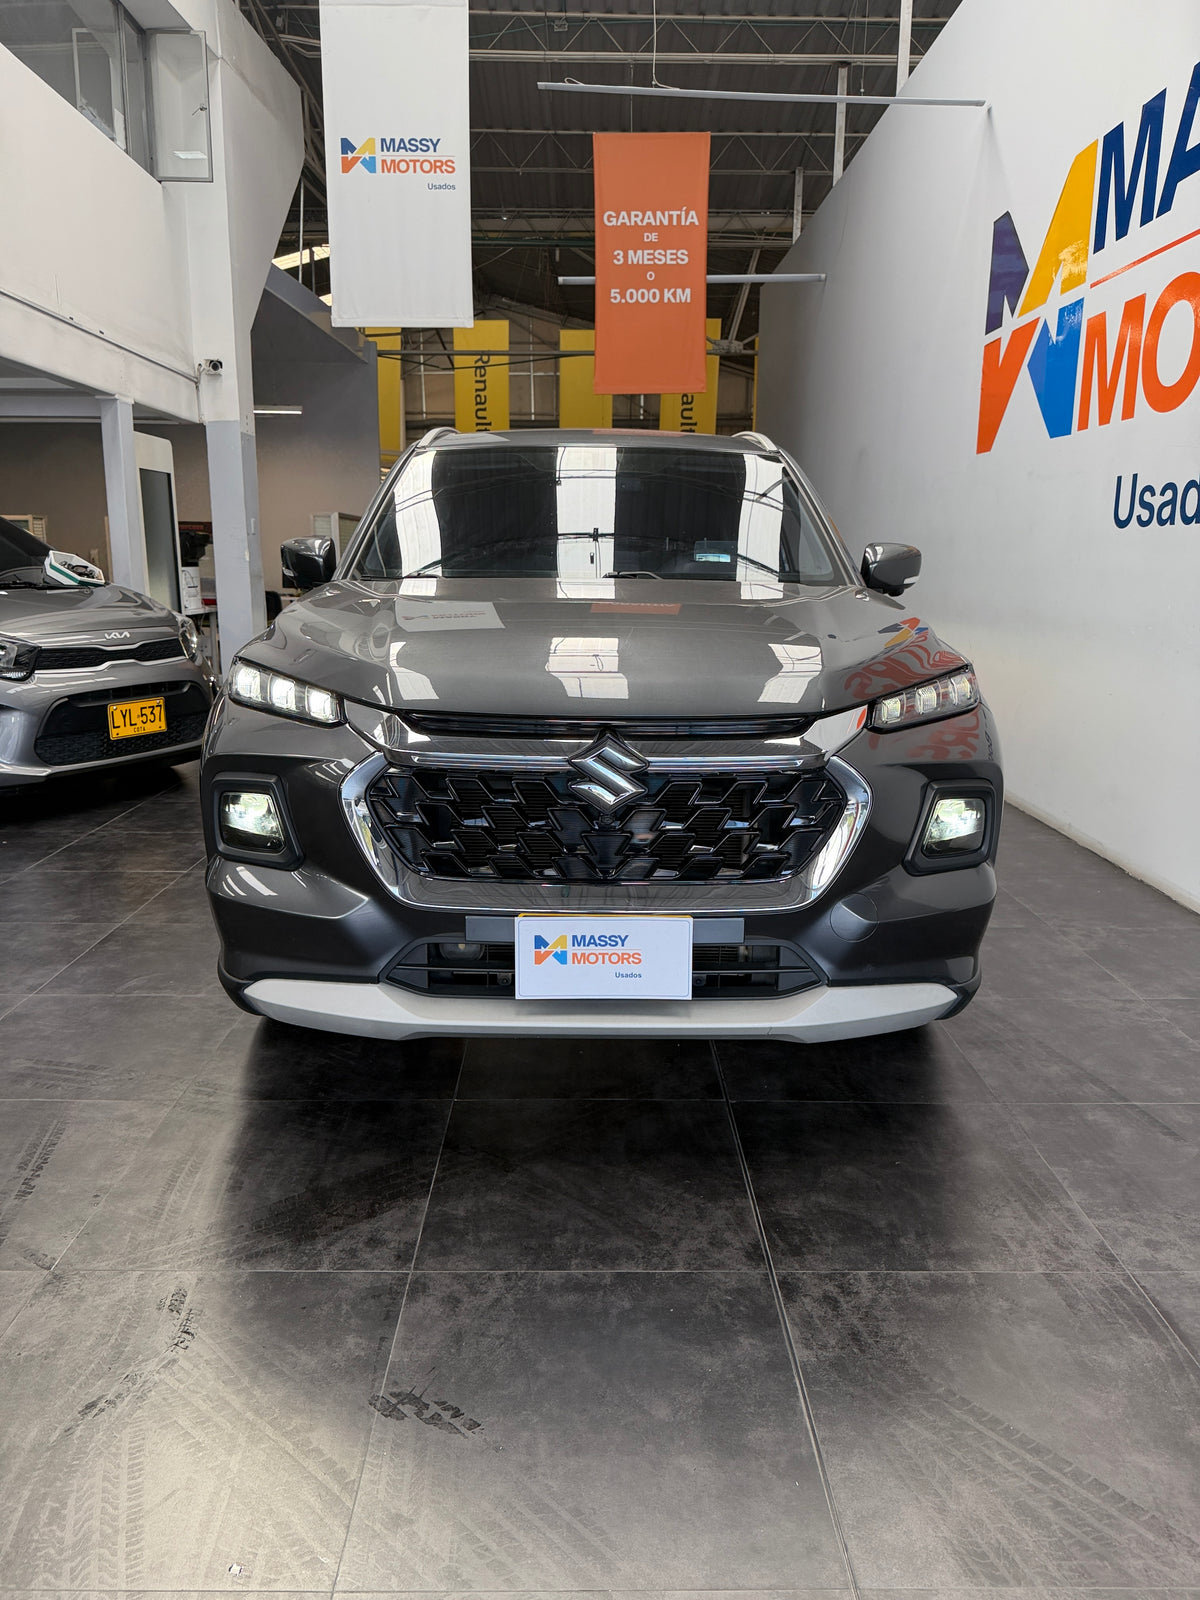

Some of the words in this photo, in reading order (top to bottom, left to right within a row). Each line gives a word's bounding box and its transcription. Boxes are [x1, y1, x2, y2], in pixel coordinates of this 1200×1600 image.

[380, 138, 441, 153] MASSY
[381, 159, 456, 174] MOTORS
[603, 207, 699, 226] GARANTÍA
[643, 232, 659, 242] DE
[613, 250, 624, 265] 3
[628, 249, 689, 265] MESES
[610, 288, 660, 304] 5.000
[663, 288, 692, 303] KM
[1113, 472, 1200, 529] Usad
[111, 708, 137, 729] LYL
[140, 704, 163, 724] 537
[572, 934, 629, 947] MASSY
[572, 952, 642, 965] MOTORS
[615, 971, 642, 979] Usados
